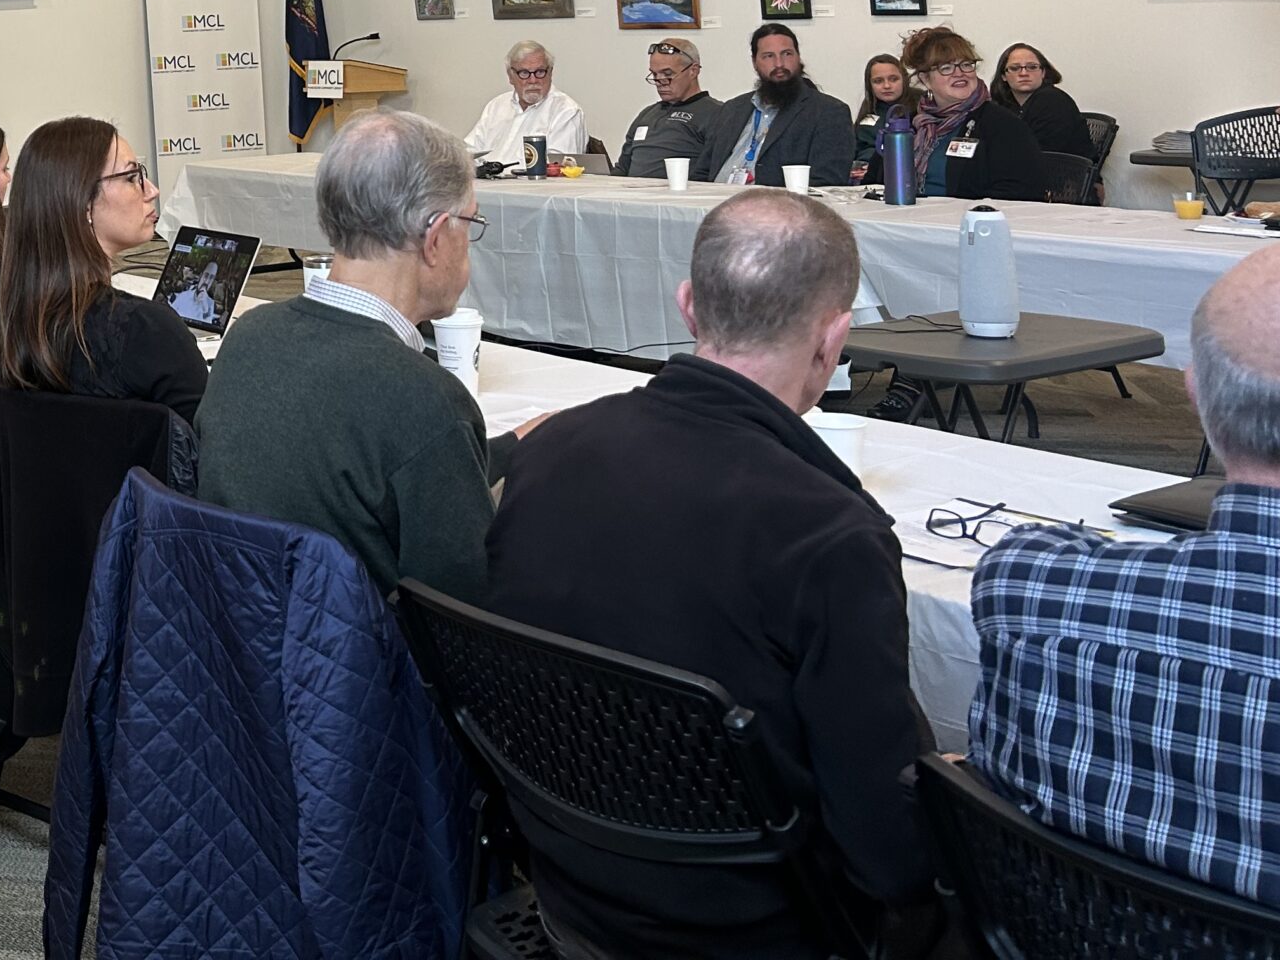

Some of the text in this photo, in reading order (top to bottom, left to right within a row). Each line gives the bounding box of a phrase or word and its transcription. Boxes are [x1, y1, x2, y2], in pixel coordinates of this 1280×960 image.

[194, 15, 224, 28] MCL
[164, 56, 195, 69] MCL
[228, 52, 258, 66] MCL
[317, 69, 343, 85] MCL
[199, 93, 229, 107] MCL
[170, 137, 200, 152] MCL
[233, 133, 263, 147] MCL
